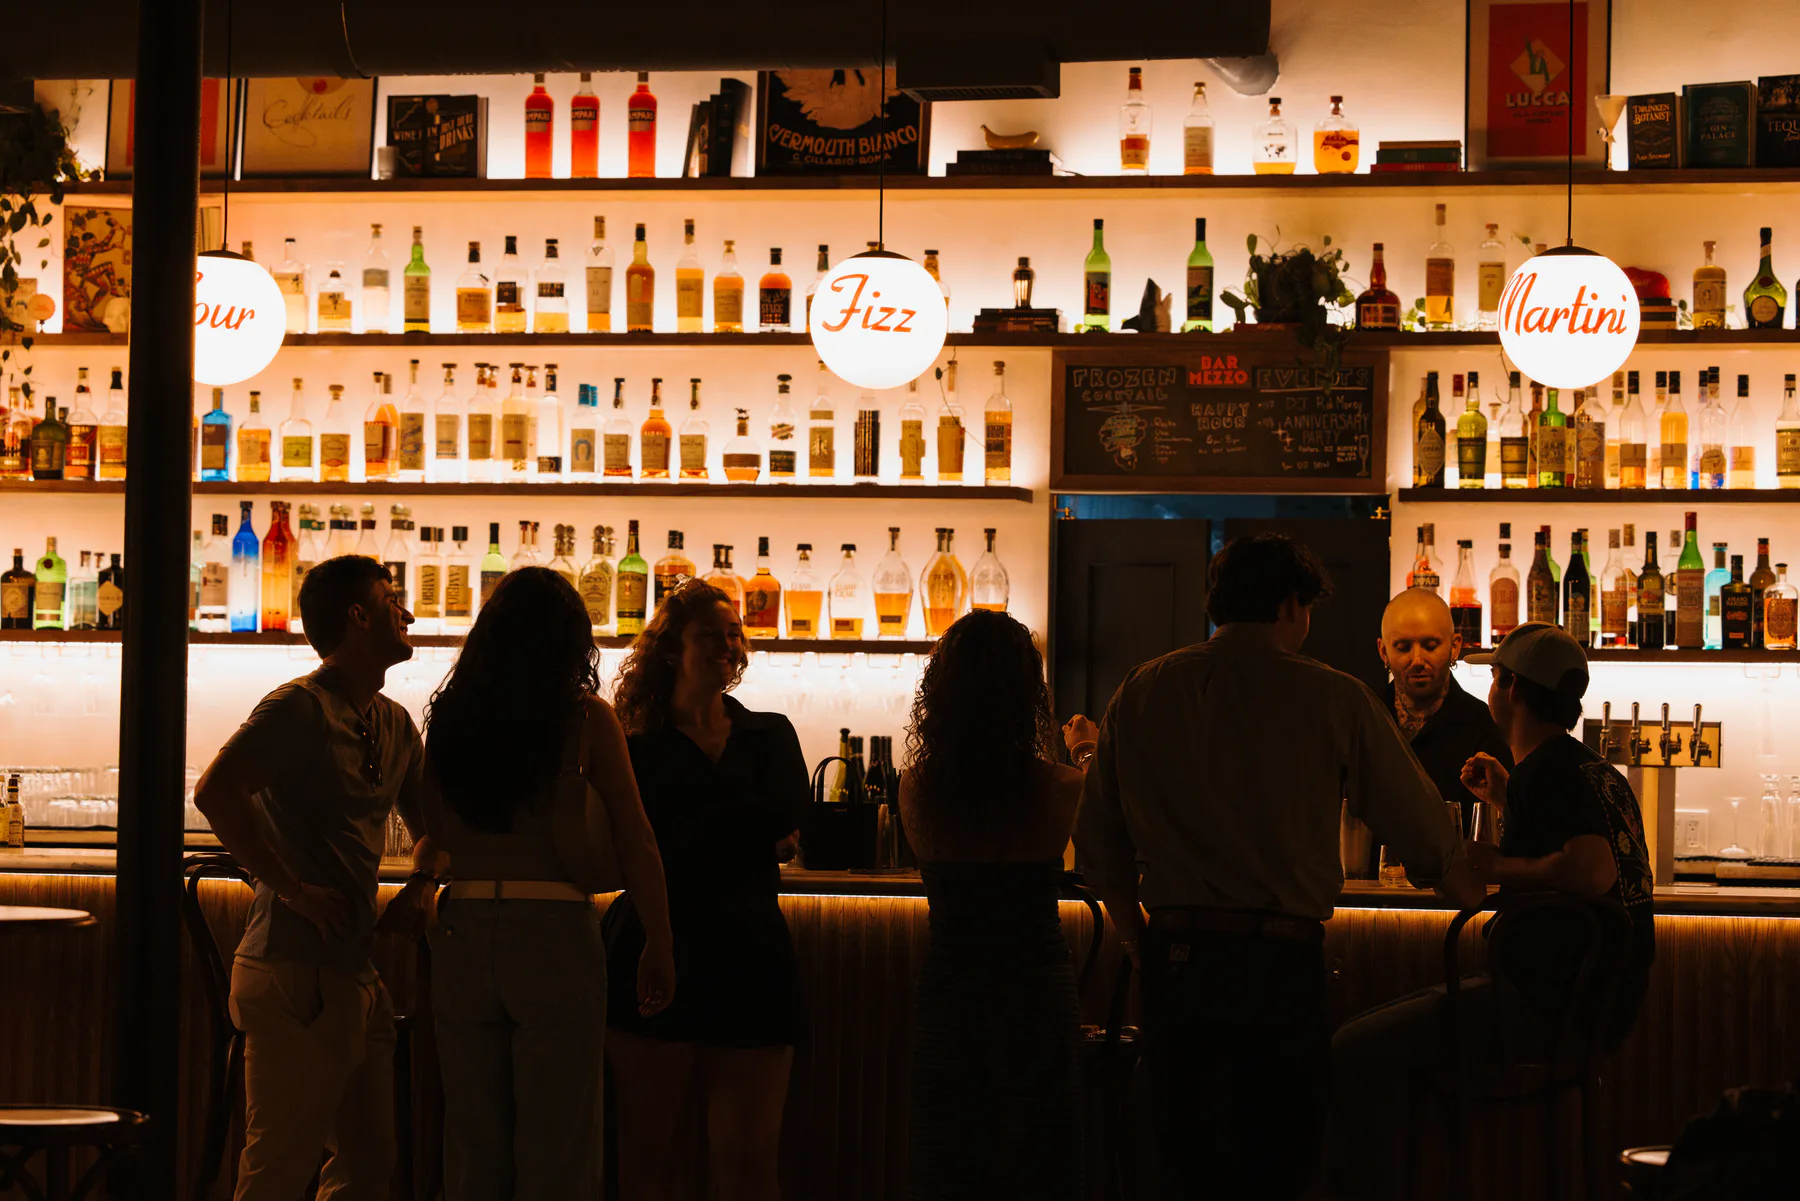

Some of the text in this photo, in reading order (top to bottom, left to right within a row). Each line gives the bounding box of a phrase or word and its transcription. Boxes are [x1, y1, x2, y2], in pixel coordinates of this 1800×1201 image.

[1506, 91, 1570, 107] LUCCA
[263, 94, 354, 133] Cocktails
[1632, 103, 1670, 114] DRUNKEN
[1633, 111, 1672, 125] BOTANIST
[769, 123, 918, 156] VERMOUTH BIANCO
[822, 273, 917, 333] Fizz
[1499, 272, 1629, 337] Martini
[1201, 355, 1239, 370] BAR
[1072, 367, 1177, 388] FROZEN
[1189, 370, 1249, 385] MEZZO
[1257, 367, 1369, 389] EVENTS
[1081, 387, 1169, 402] COCKTAIL
[1191, 402, 1251, 417] HAPPY
[1197, 416, 1246, 431] HOUR
[1283, 413, 1370, 432] ANNIVERSARY
[1302, 430, 1341, 446] PARTY
